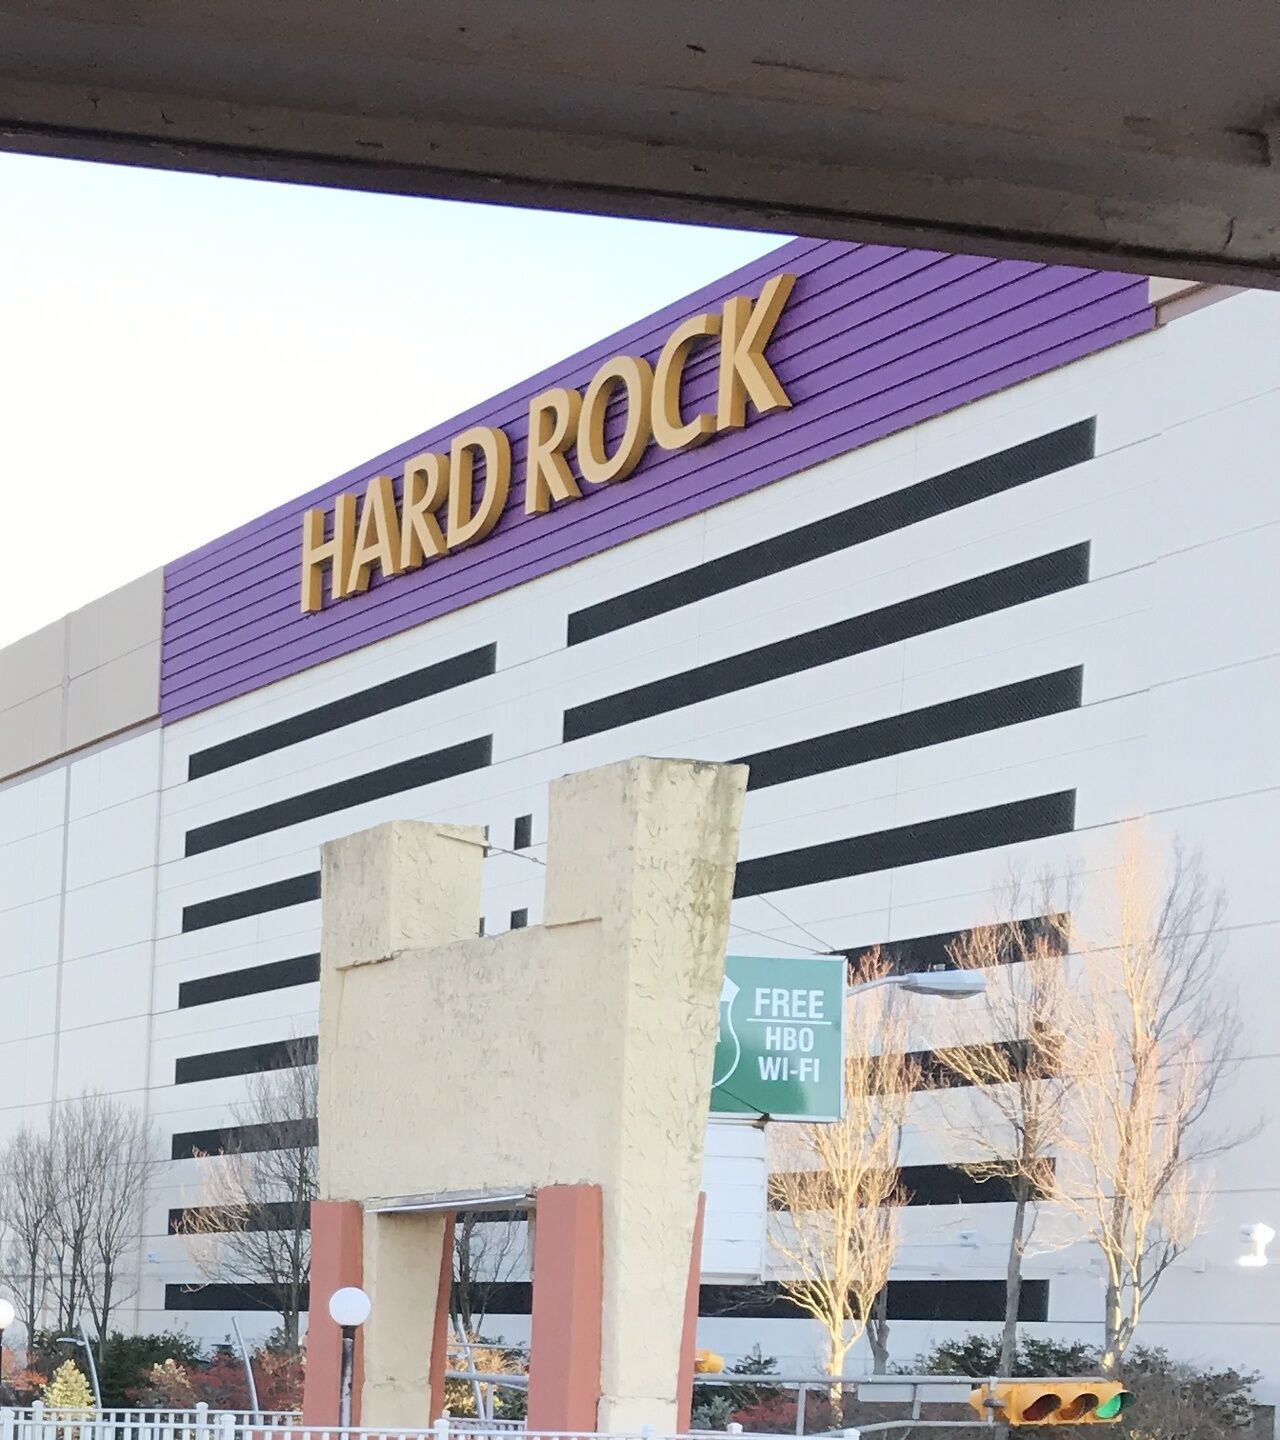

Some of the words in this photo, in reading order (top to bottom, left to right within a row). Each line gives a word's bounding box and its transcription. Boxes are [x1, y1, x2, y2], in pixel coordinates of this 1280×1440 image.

[300, 426, 512, 615] HARD
[524, 272, 798, 516] ROCK
[754, 987, 825, 1019] FREE
[765, 1026, 815, 1053] HBO
[757, 1056, 820, 1083] WI-FI
